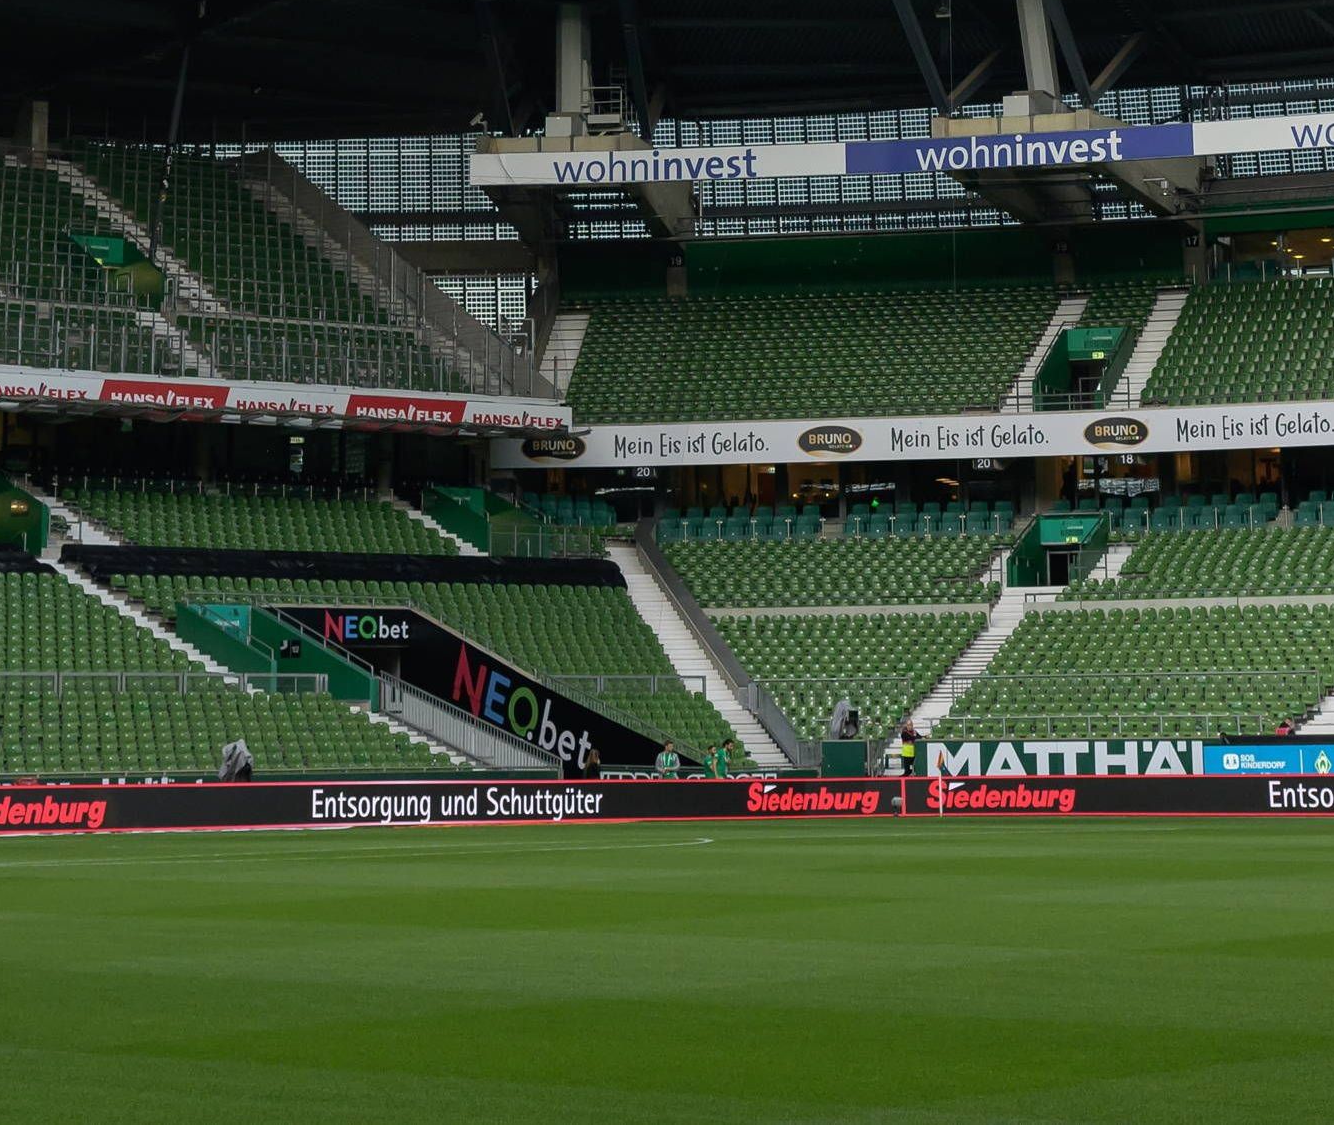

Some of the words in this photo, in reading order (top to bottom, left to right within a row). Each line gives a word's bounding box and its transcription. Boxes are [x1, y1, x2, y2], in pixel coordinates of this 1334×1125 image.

[917, 130, 1123, 171] wohninvest
[553, 147, 757, 183] wohninvest
[808, 433, 852, 445] BRUNO
[891, 427, 930, 451] Mein
[937, 426, 960, 450] Eis
[965, 425, 985, 447] ist
[991, 423, 1049, 447] Gelato.
[1095, 426, 1138, 437] BRUNO
[1177, 418, 1216, 442] Mein
[1222, 416, 1243, 440] Eis
[1250, 413, 1270, 437] ist
[614, 434, 653, 458] Mein
[660, 434, 681, 456] Eis
[687, 432, 705, 454] ist
[711, 431, 770, 454] Gelato.
[636, 467, 651, 477] 20
[977, 459, 990, 469] 20
[1121, 455, 1134, 464] 18
[311, 788, 432, 824] Entsorgung
[441, 787, 477, 816] und
[487, 786, 603, 823] Schuttgüter
[747, 781, 880, 814] Siedenburg
[926, 779, 1076, 813] Siedenburg
